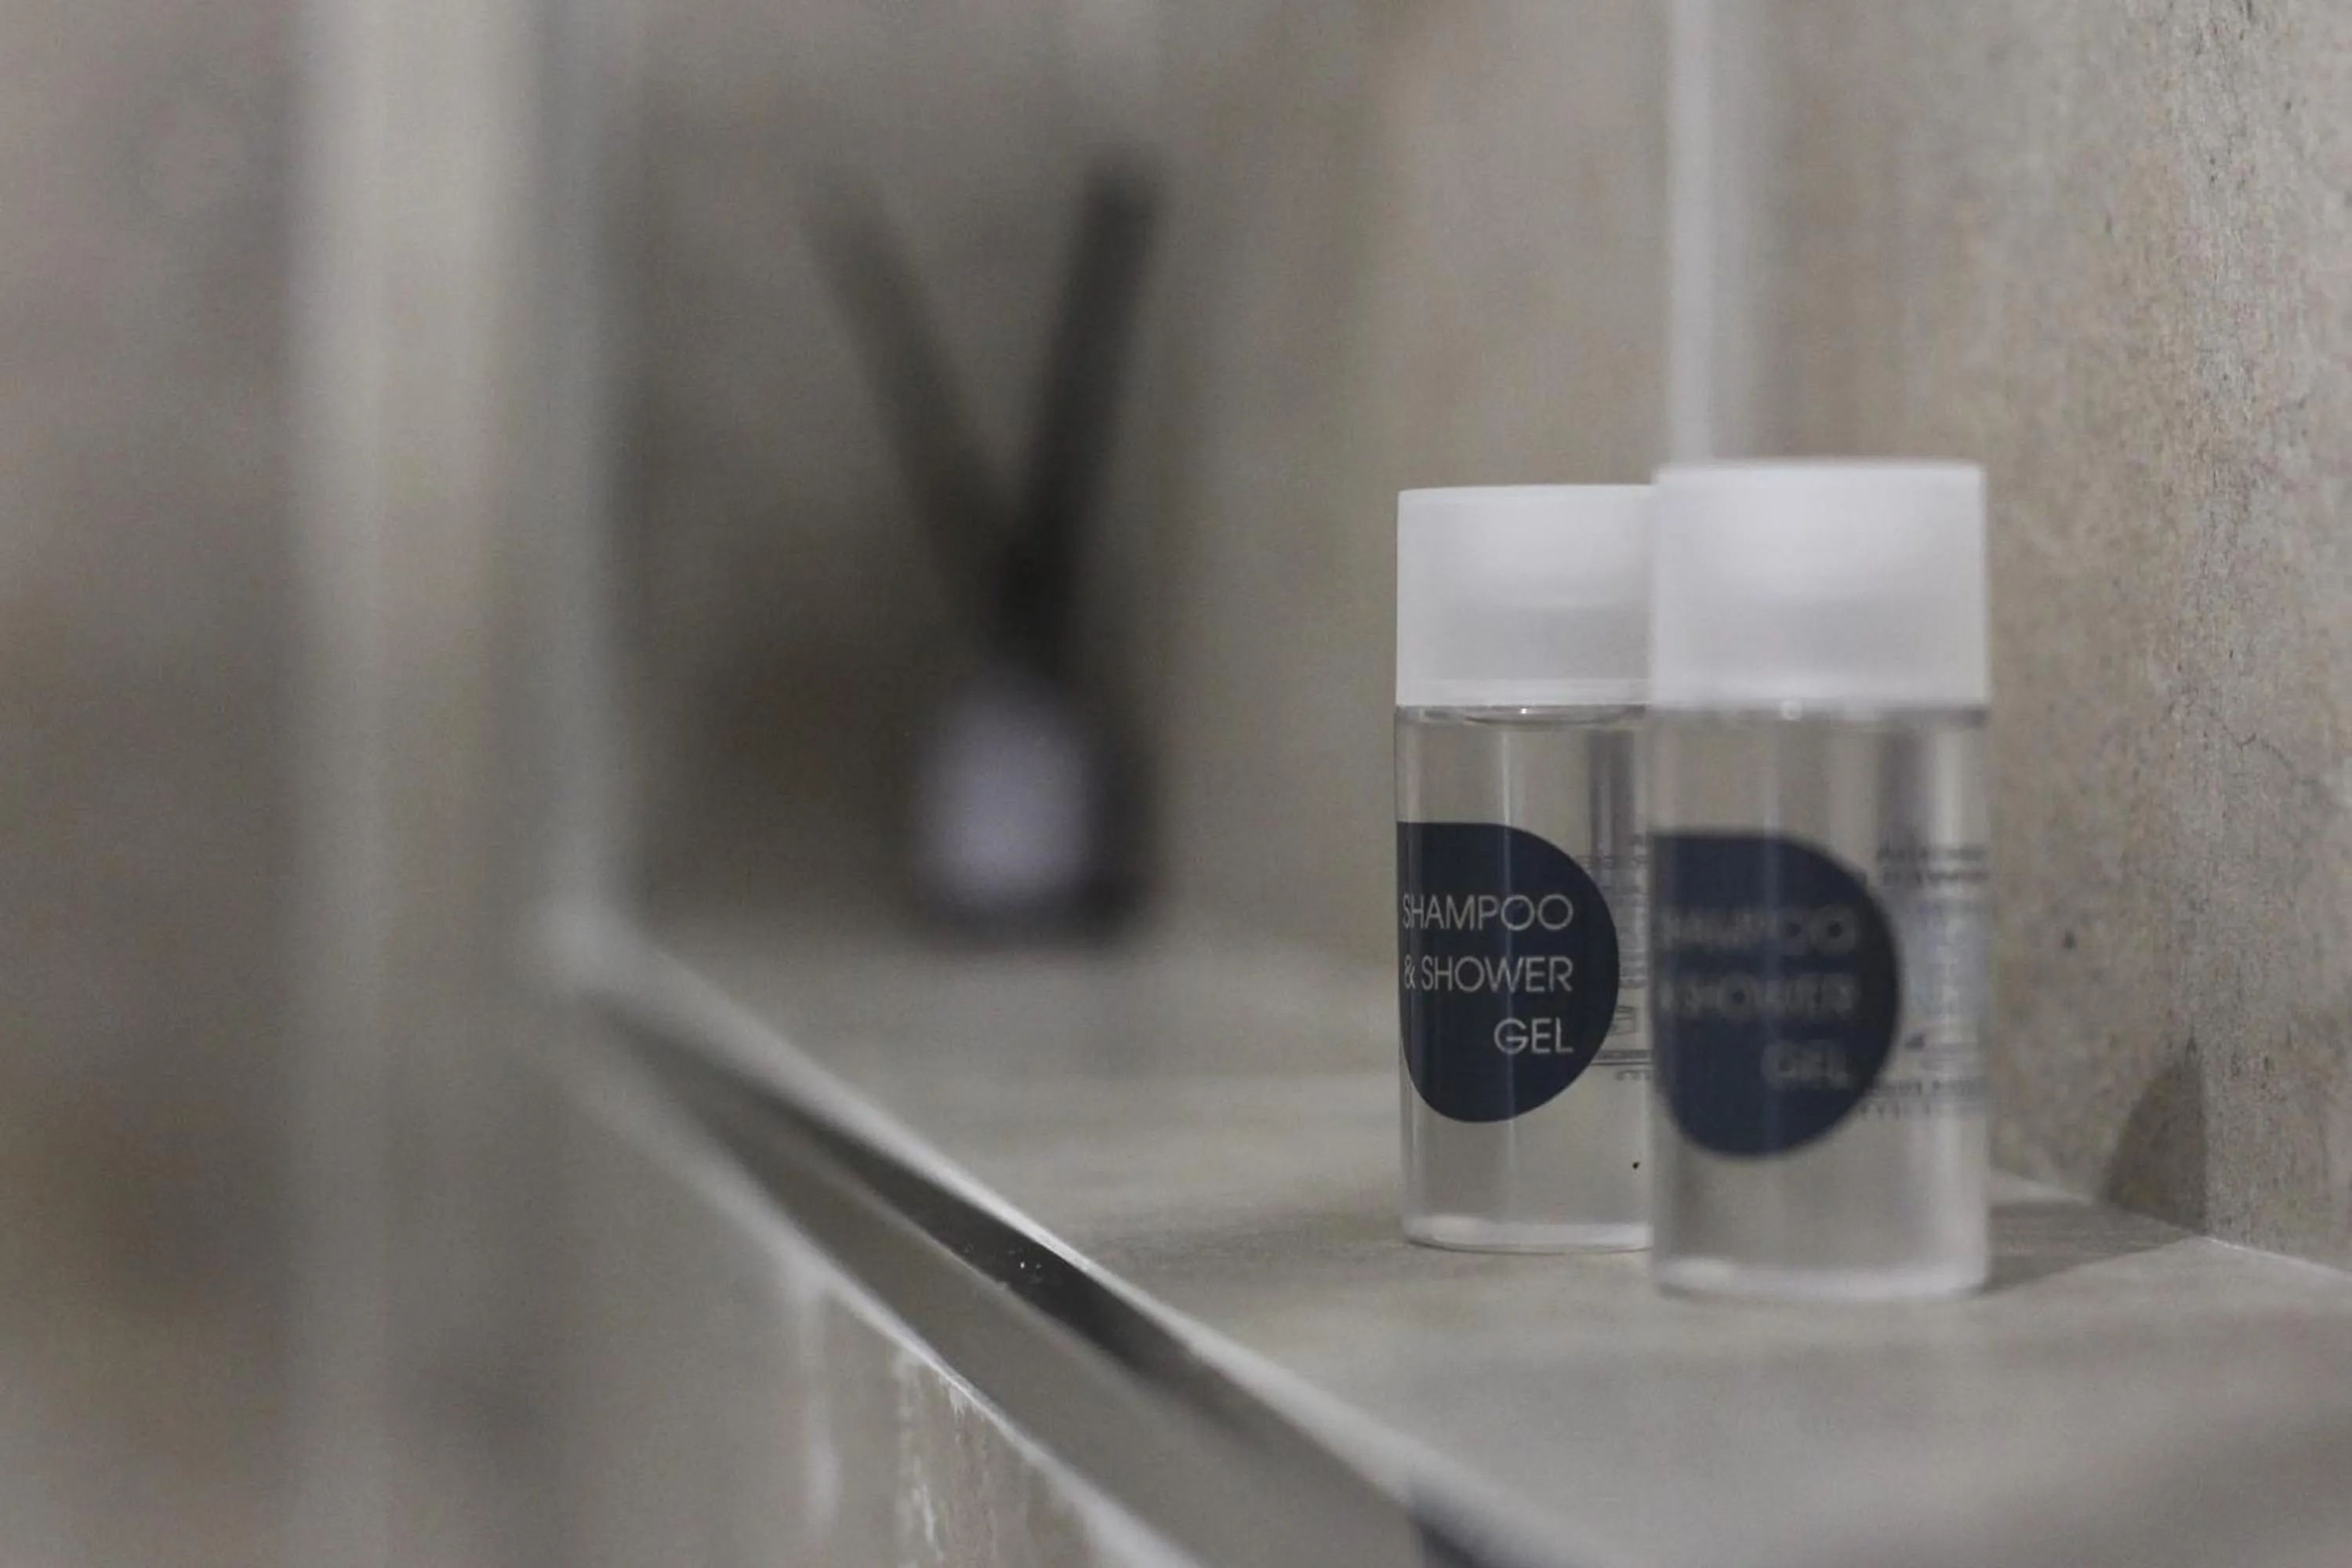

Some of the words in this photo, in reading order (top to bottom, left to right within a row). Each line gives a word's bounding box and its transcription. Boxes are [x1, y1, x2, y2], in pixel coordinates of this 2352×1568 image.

[1402, 892, 1574, 931] SHAMPOO
[1403, 954, 1416, 991] &
[1421, 955, 1574, 993] SHOWER
[1493, 1017, 1574, 1054] GEL
